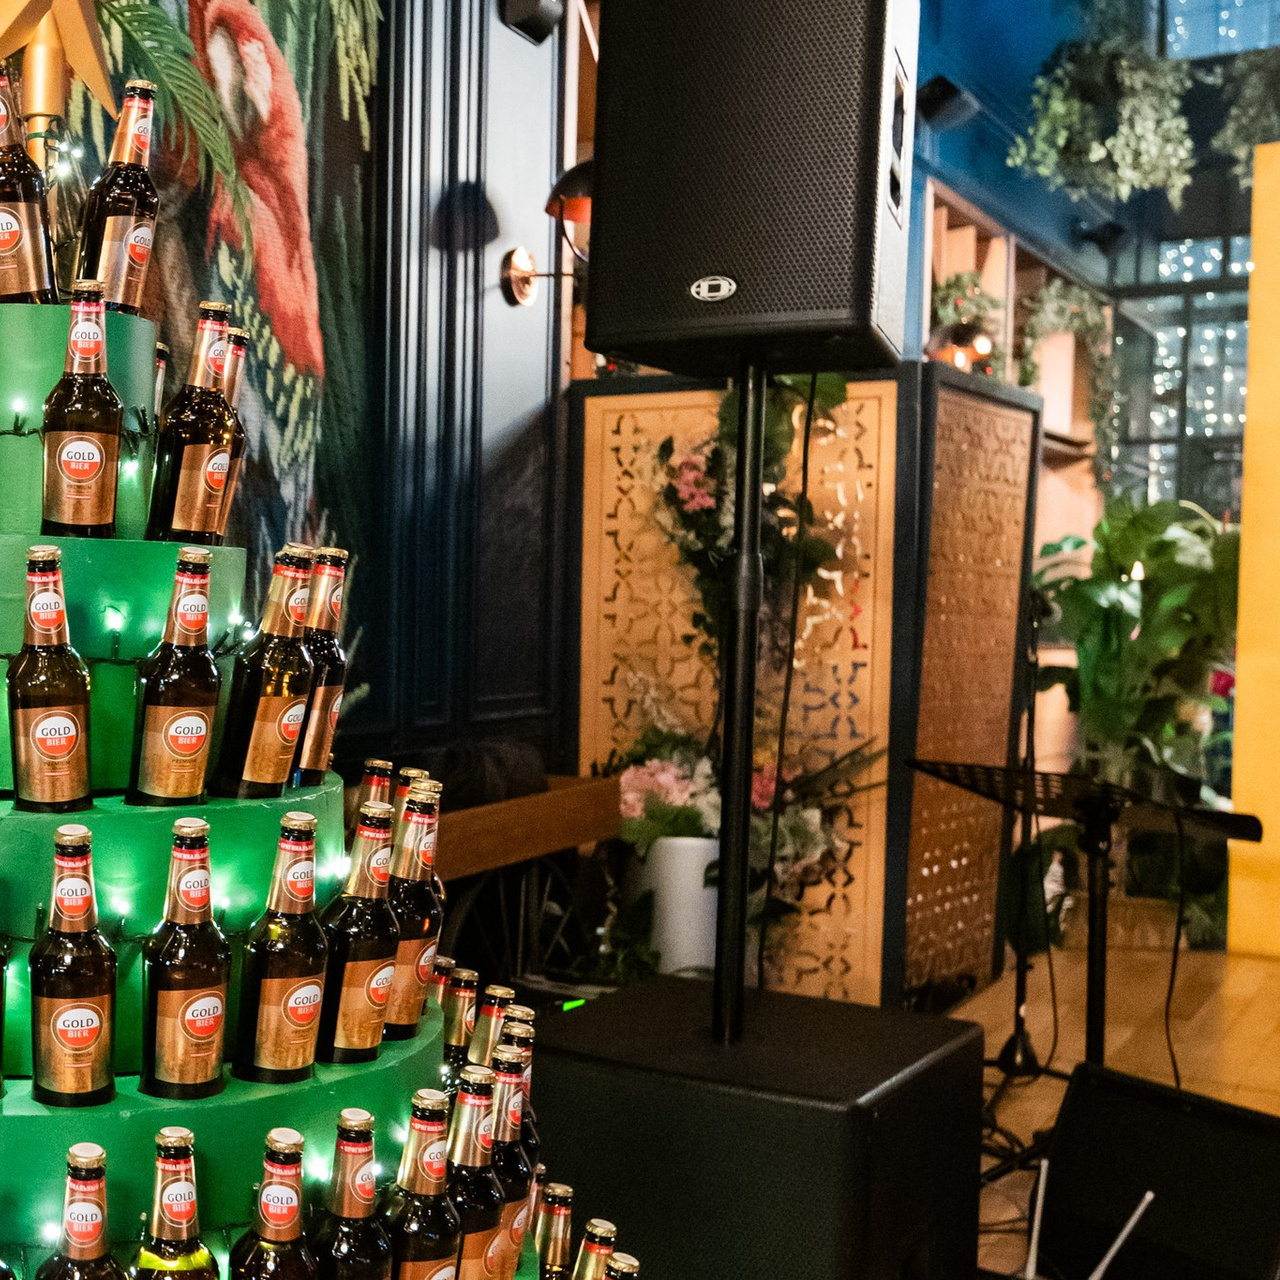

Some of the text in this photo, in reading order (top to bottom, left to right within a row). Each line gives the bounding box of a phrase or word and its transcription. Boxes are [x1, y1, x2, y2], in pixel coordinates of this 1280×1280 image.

[74, 330, 99, 340] GOLD
[77, 340, 95, 349] BIER
[66, 450, 95, 461] GOLD
[70, 461, 90, 470] BIER
[34, 601, 60, 612] GOLD
[182, 603, 207, 613] GOLD
[39, 611, 58, 620] BIER
[186, 612, 204, 621] BIER
[41, 726, 71, 737] GOLD
[174, 725, 202, 736] GOLD
[46, 737, 67, 747] BIER
[178, 736, 198, 745] BIER
[184, 879, 209, 890] GOLD
[60, 886, 87, 898] GOLD
[189, 889, 207, 898] BIER
[64, 897, 84, 907] BIER
[294, 993, 318, 1006] GOLD
[191, 1006, 219, 1018] GOLD
[62, 1017, 94, 1029] GOLD
[195, 1017, 215, 1028] BIER
[67, 1028, 90, 1038] BIER
[167, 1192, 193, 1203] GOLD
[265, 1193, 294, 1205] GOLD
[172, 1202, 191, 1213] BIER
[268, 1204, 288, 1215] BIER
[69, 1211, 99, 1222] GOLD
[73, 1223, 93, 1233] BIER
